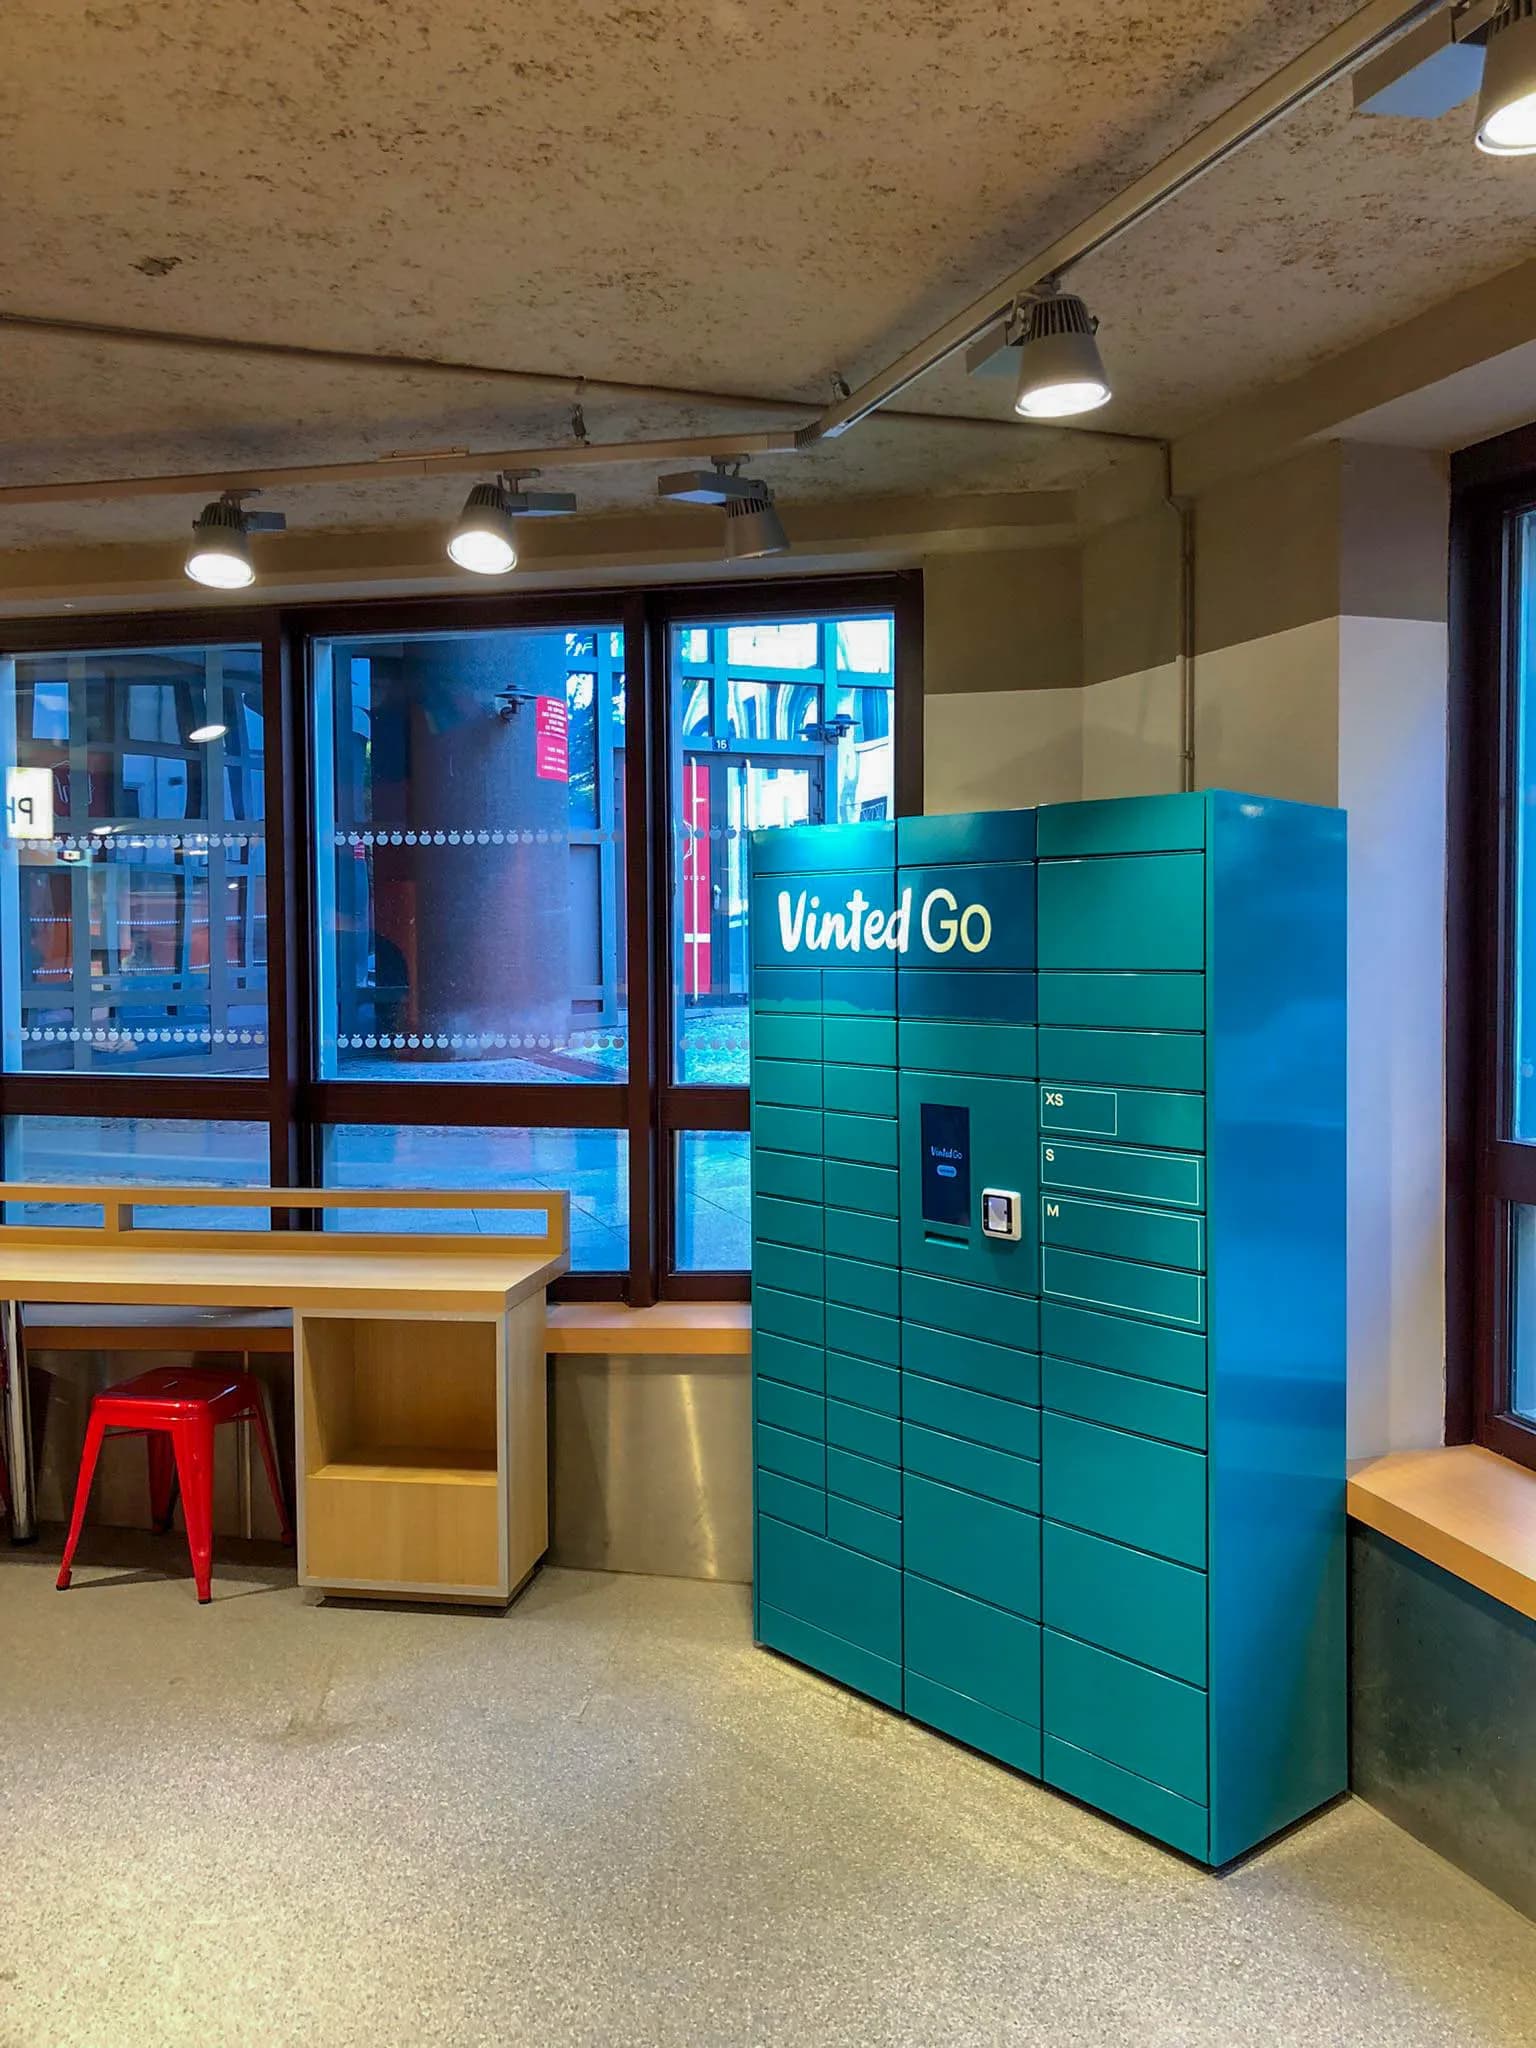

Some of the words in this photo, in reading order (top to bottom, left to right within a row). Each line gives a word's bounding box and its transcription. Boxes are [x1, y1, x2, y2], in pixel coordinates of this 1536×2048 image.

[778, 887, 912, 953] Vinted
[921, 887, 992, 954] Go
[1045, 1093, 1064, 1107] XS
[1045, 1149, 1055, 1162] S
[1047, 1204, 1060, 1217] M
